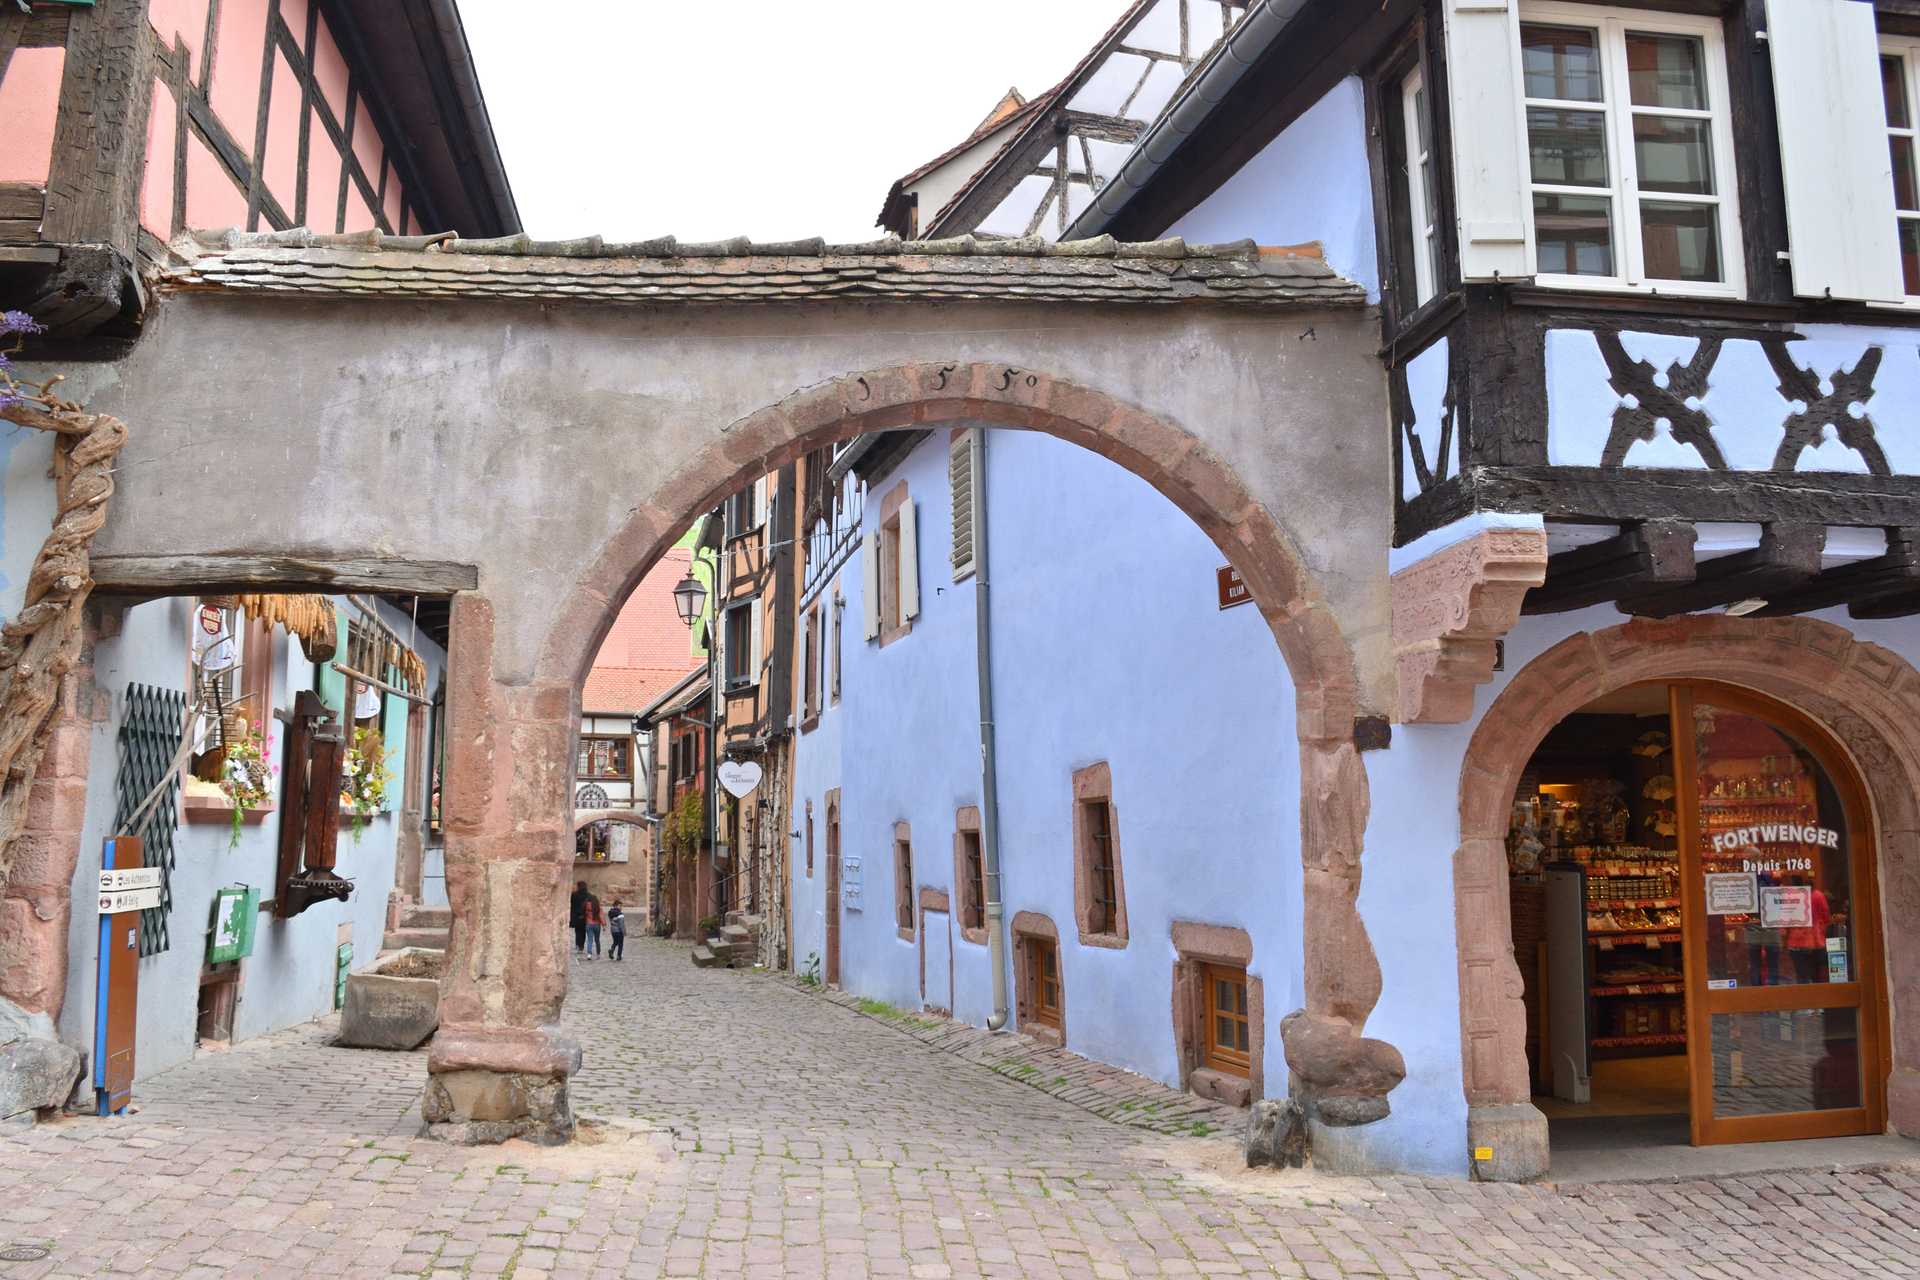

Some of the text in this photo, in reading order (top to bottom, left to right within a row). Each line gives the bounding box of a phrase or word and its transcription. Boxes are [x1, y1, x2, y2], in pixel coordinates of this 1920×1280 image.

[1712, 823, 1839, 852] FORTWENGER
[1742, 858, 1811, 874] Depuis 1768
